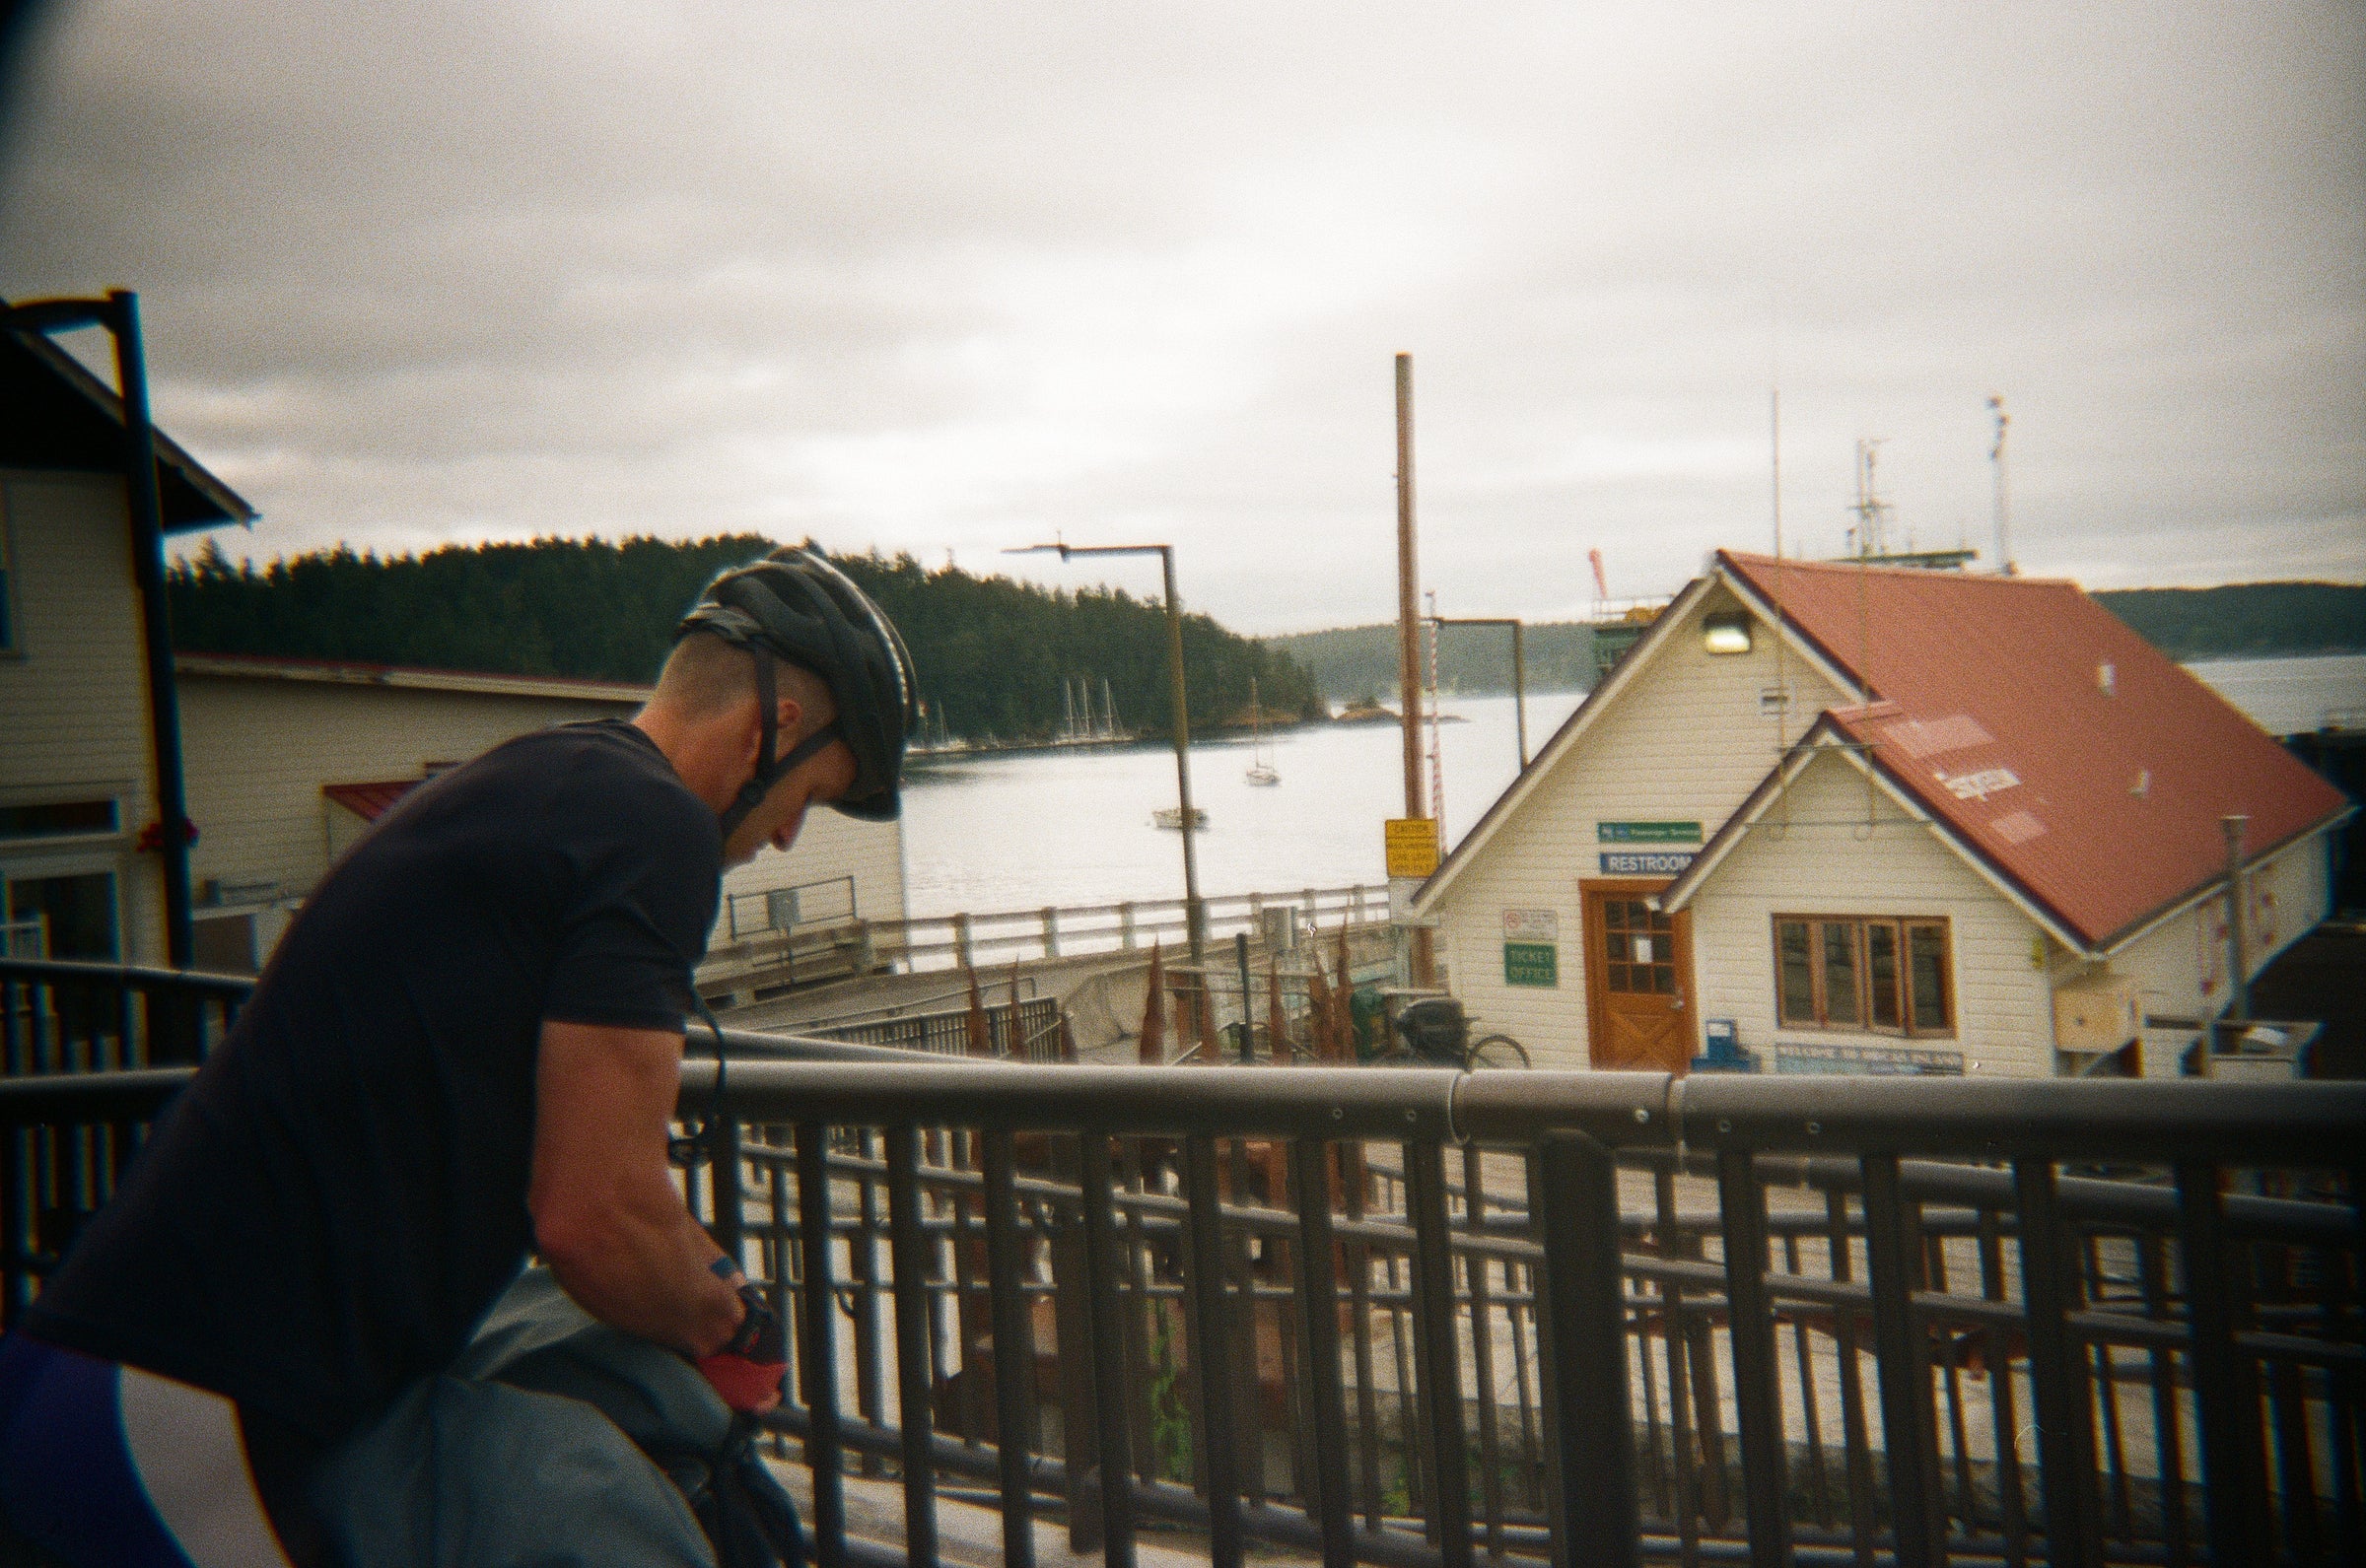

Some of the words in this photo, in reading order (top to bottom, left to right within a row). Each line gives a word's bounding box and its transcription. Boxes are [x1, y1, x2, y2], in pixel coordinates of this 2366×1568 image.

[1609, 855, 1693, 871] RESTROOM
[1510, 950, 1551, 963] TICKET
[1509, 966, 1553, 980] OFFICE
